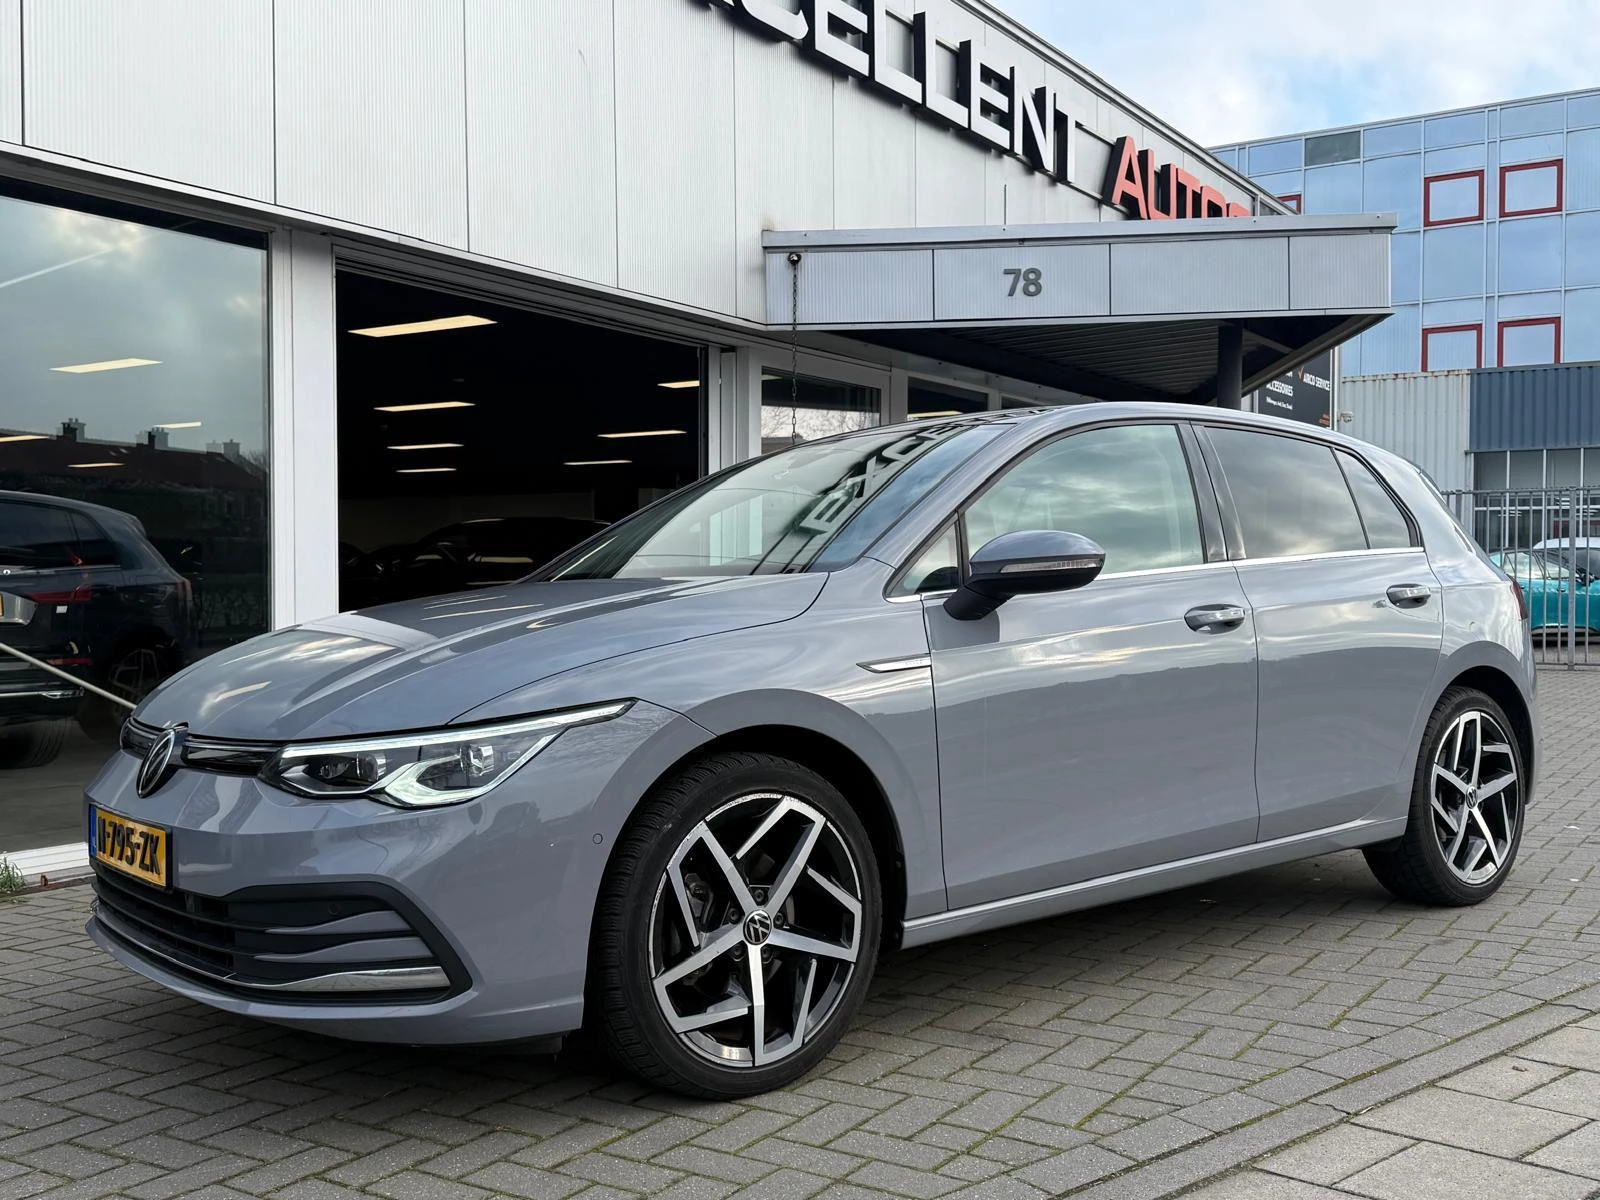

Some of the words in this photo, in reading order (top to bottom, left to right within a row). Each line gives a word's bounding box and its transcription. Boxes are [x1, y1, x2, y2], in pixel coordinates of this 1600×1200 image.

[724, 0, 1083, 184] ELLENT
[1104, 135, 1251, 219] AUT
[1003, 268, 1043, 298] 78
